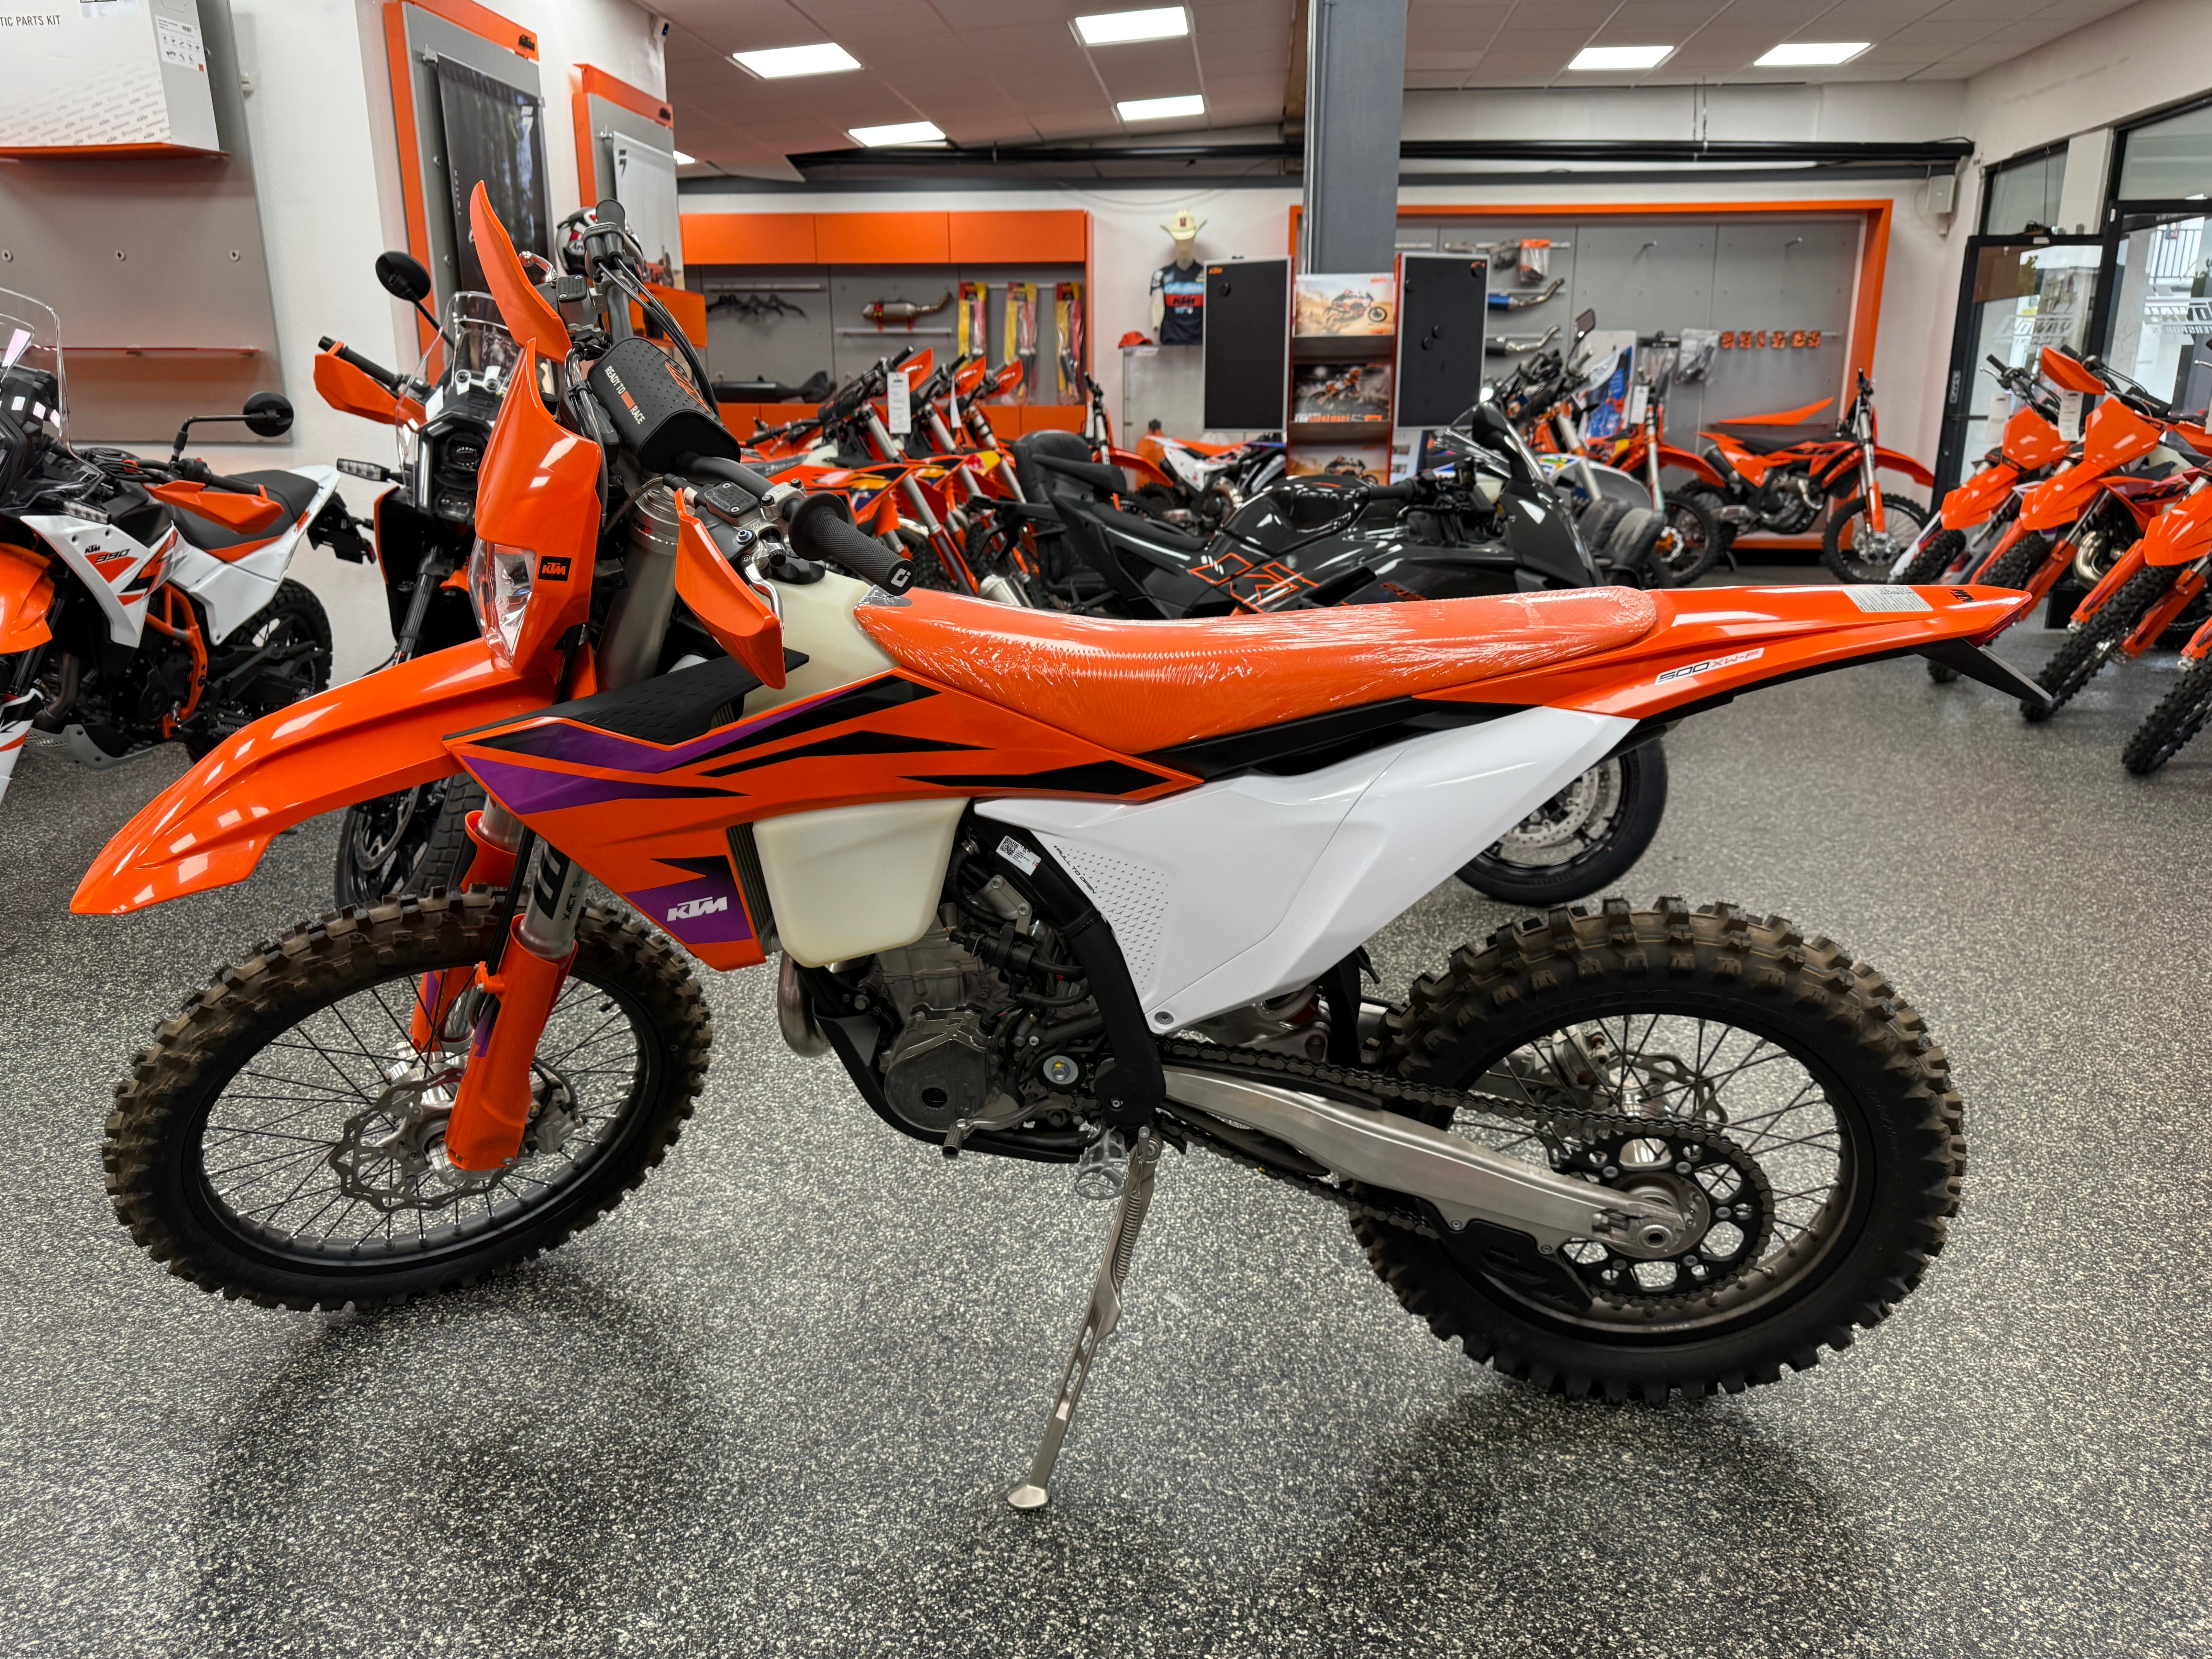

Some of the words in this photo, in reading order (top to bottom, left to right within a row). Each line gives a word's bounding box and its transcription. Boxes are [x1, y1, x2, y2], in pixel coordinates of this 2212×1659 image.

[16, 15, 44, 26] PARTS
[47, 15, 60, 25] KIT
[605, 366, 621, 386] READY
[616, 383, 626, 395] TO
[630, 405, 646, 424] RACE
[85, 544, 100, 554] KTM
[542, 562, 566, 575] KTM
[1056, 848, 1071, 866] PULL
[1072, 866, 1080, 875] TO
[1080, 876, 1097, 893] OPEN
[562, 893, 577, 921] XACT
[667, 896, 728, 922] KTM
